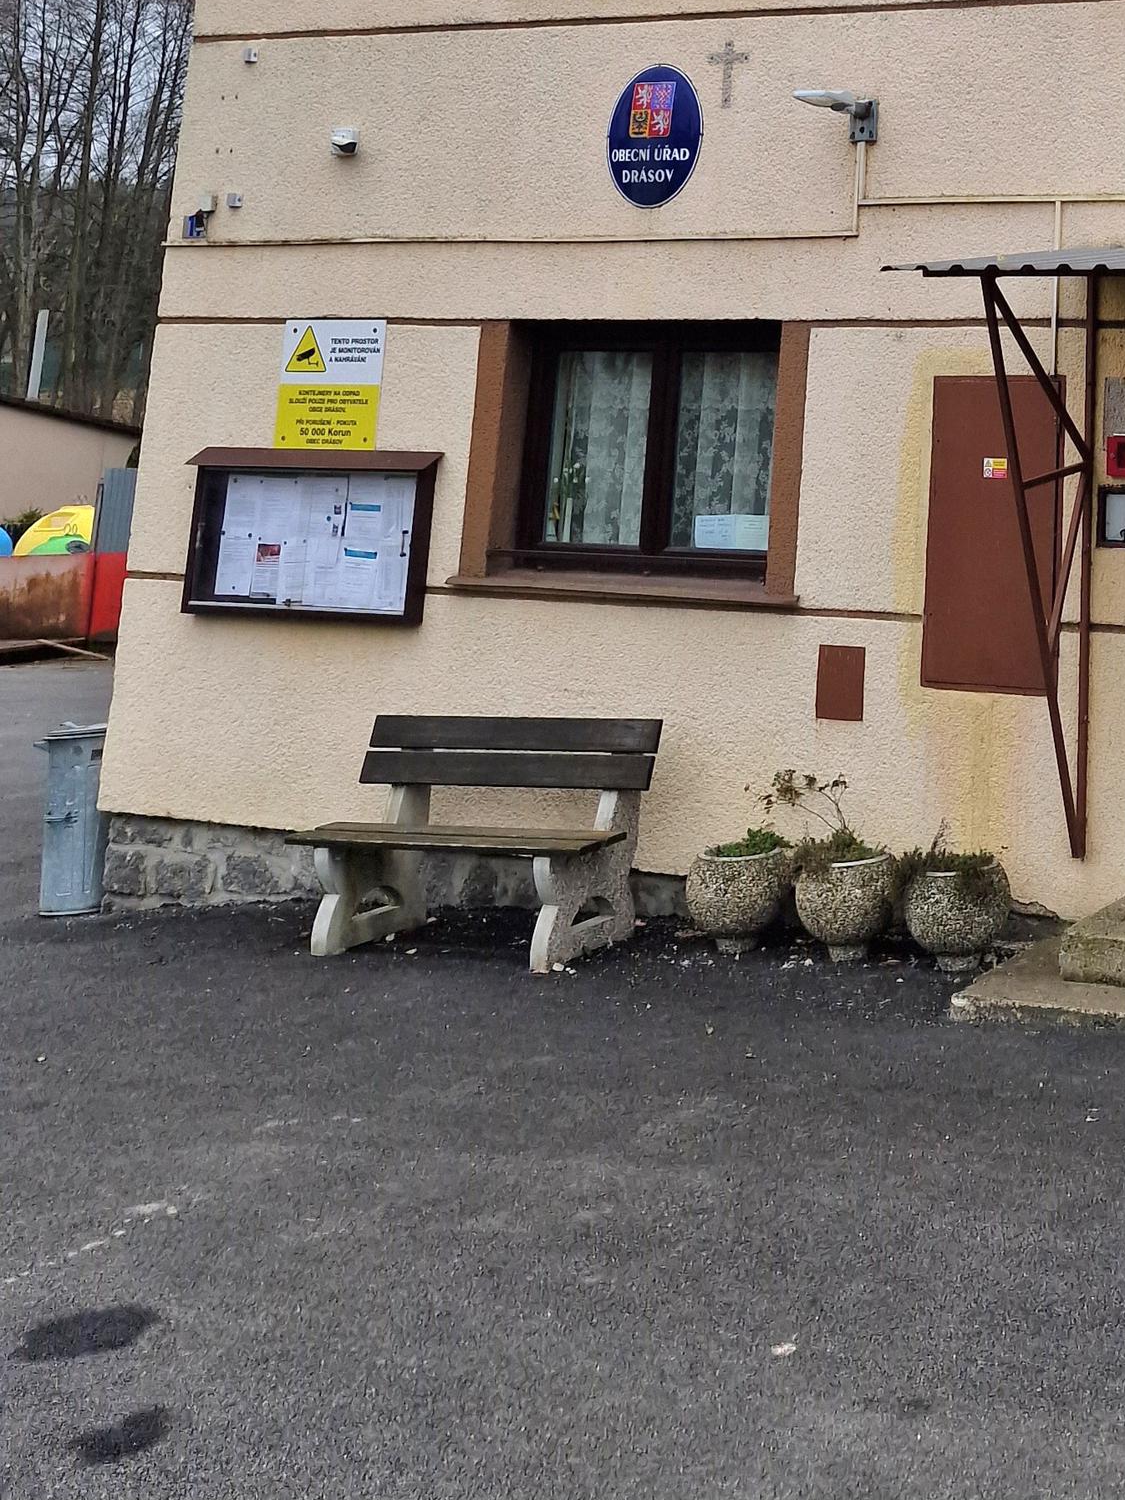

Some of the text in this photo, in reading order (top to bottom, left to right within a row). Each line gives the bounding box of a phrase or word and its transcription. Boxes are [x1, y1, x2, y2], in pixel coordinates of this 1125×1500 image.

[611, 144, 690, 162] OBECNÍ ÚŘAD
[622, 166, 674, 183] DRÁSOV
[299, 428, 351, 437] 50 000 Korun
[321, 437, 343, 445] DRÁSOV
